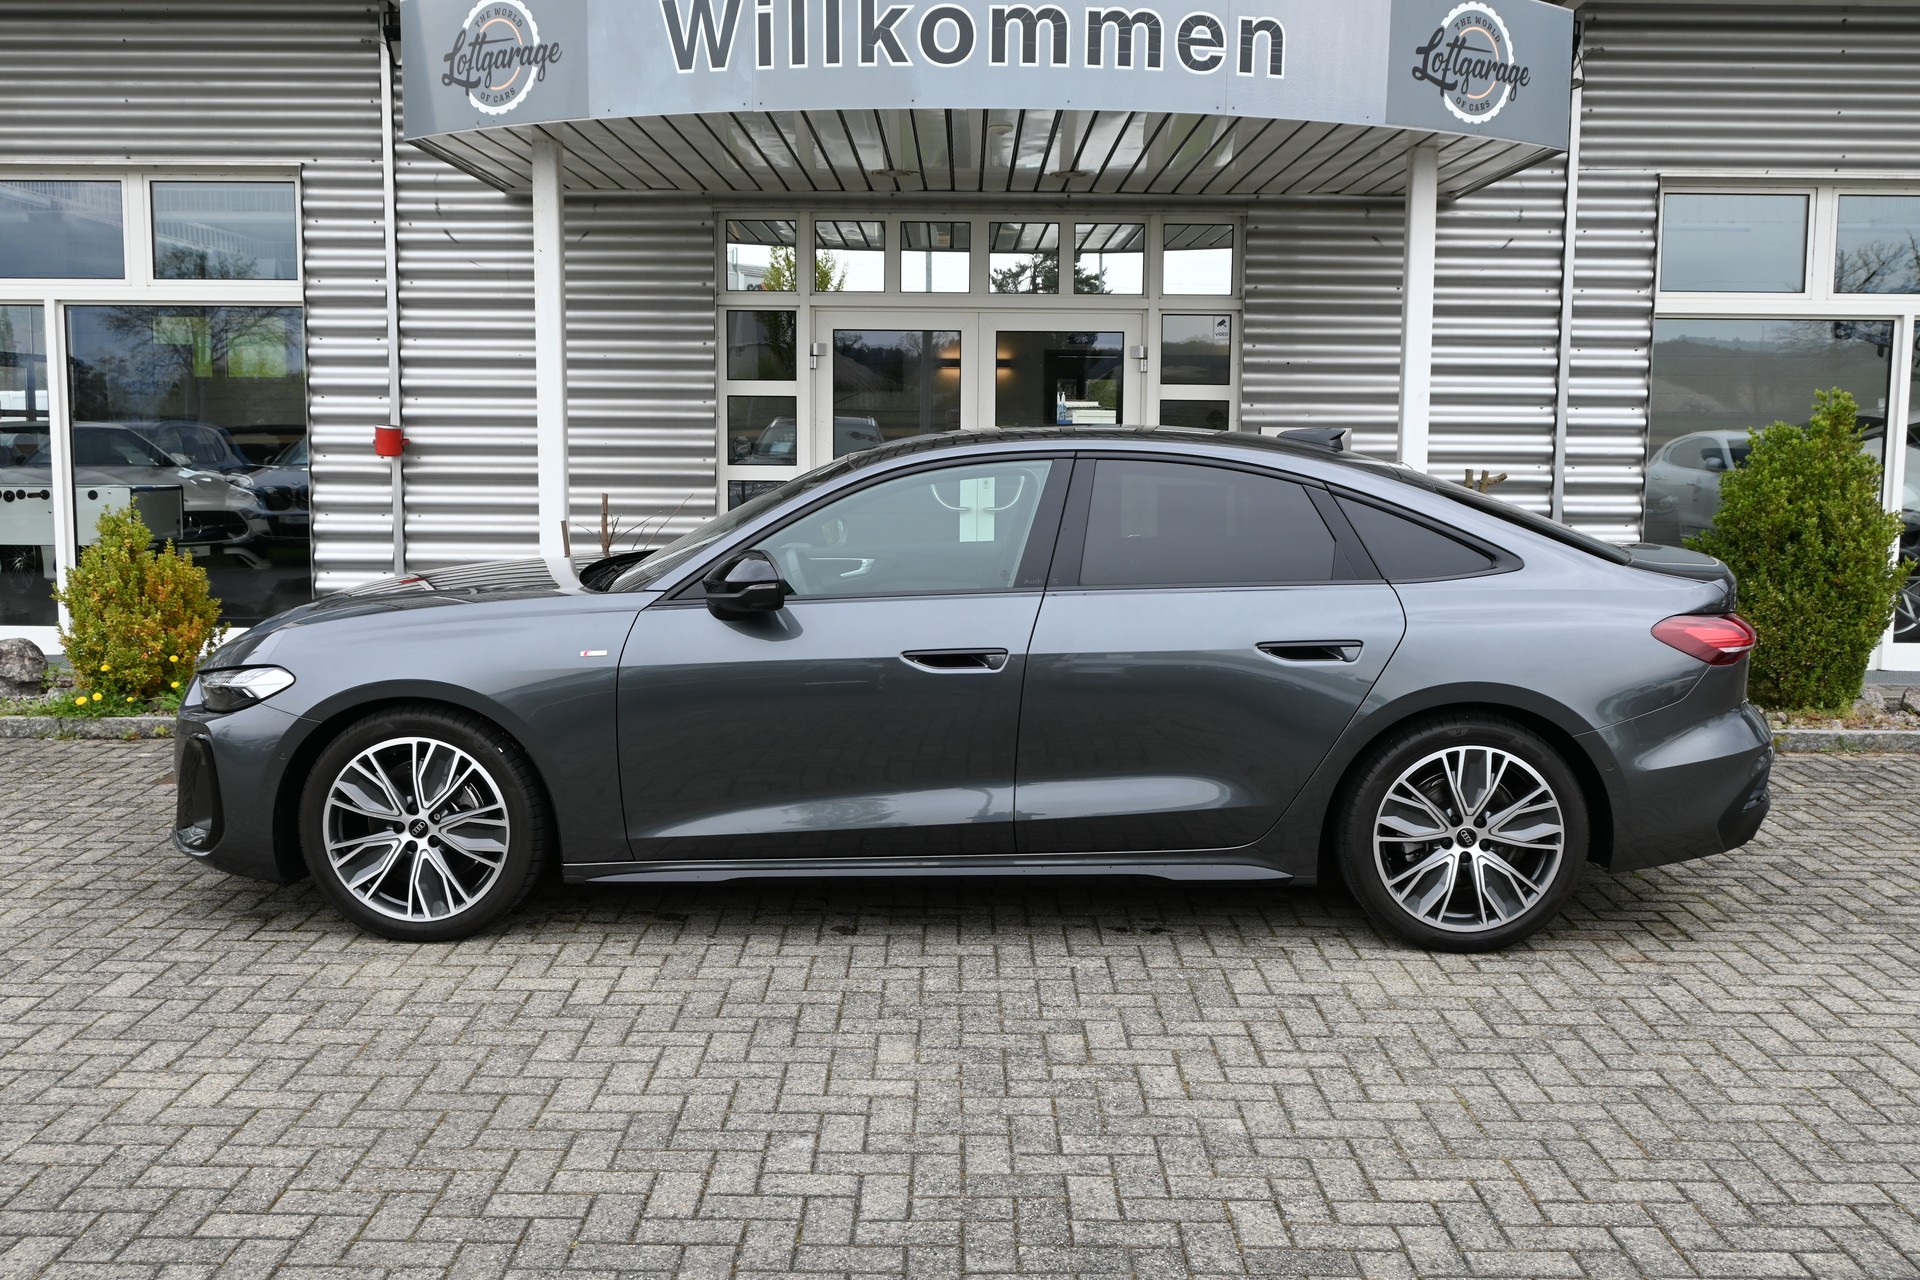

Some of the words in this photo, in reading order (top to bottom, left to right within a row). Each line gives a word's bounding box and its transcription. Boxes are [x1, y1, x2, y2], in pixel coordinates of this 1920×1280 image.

[474, 10, 491, 28] THE
[494, 8, 523, 28] WORLD
[1454, 16, 1472, 31] THE
[1475, 16, 1501, 43] WORLD
[660, 0, 1286, 79] Willkommen
[441, 29, 563, 97] Loftgarage
[1412, 26, 1531, 102] Loftgarage
[480, 91, 491, 102] OF
[493, 87, 516, 103] CARS
[1456, 96, 1467, 108] OF
[1469, 99, 1491, 112] CARS
[1023, 577, 1043, 585] Audi
